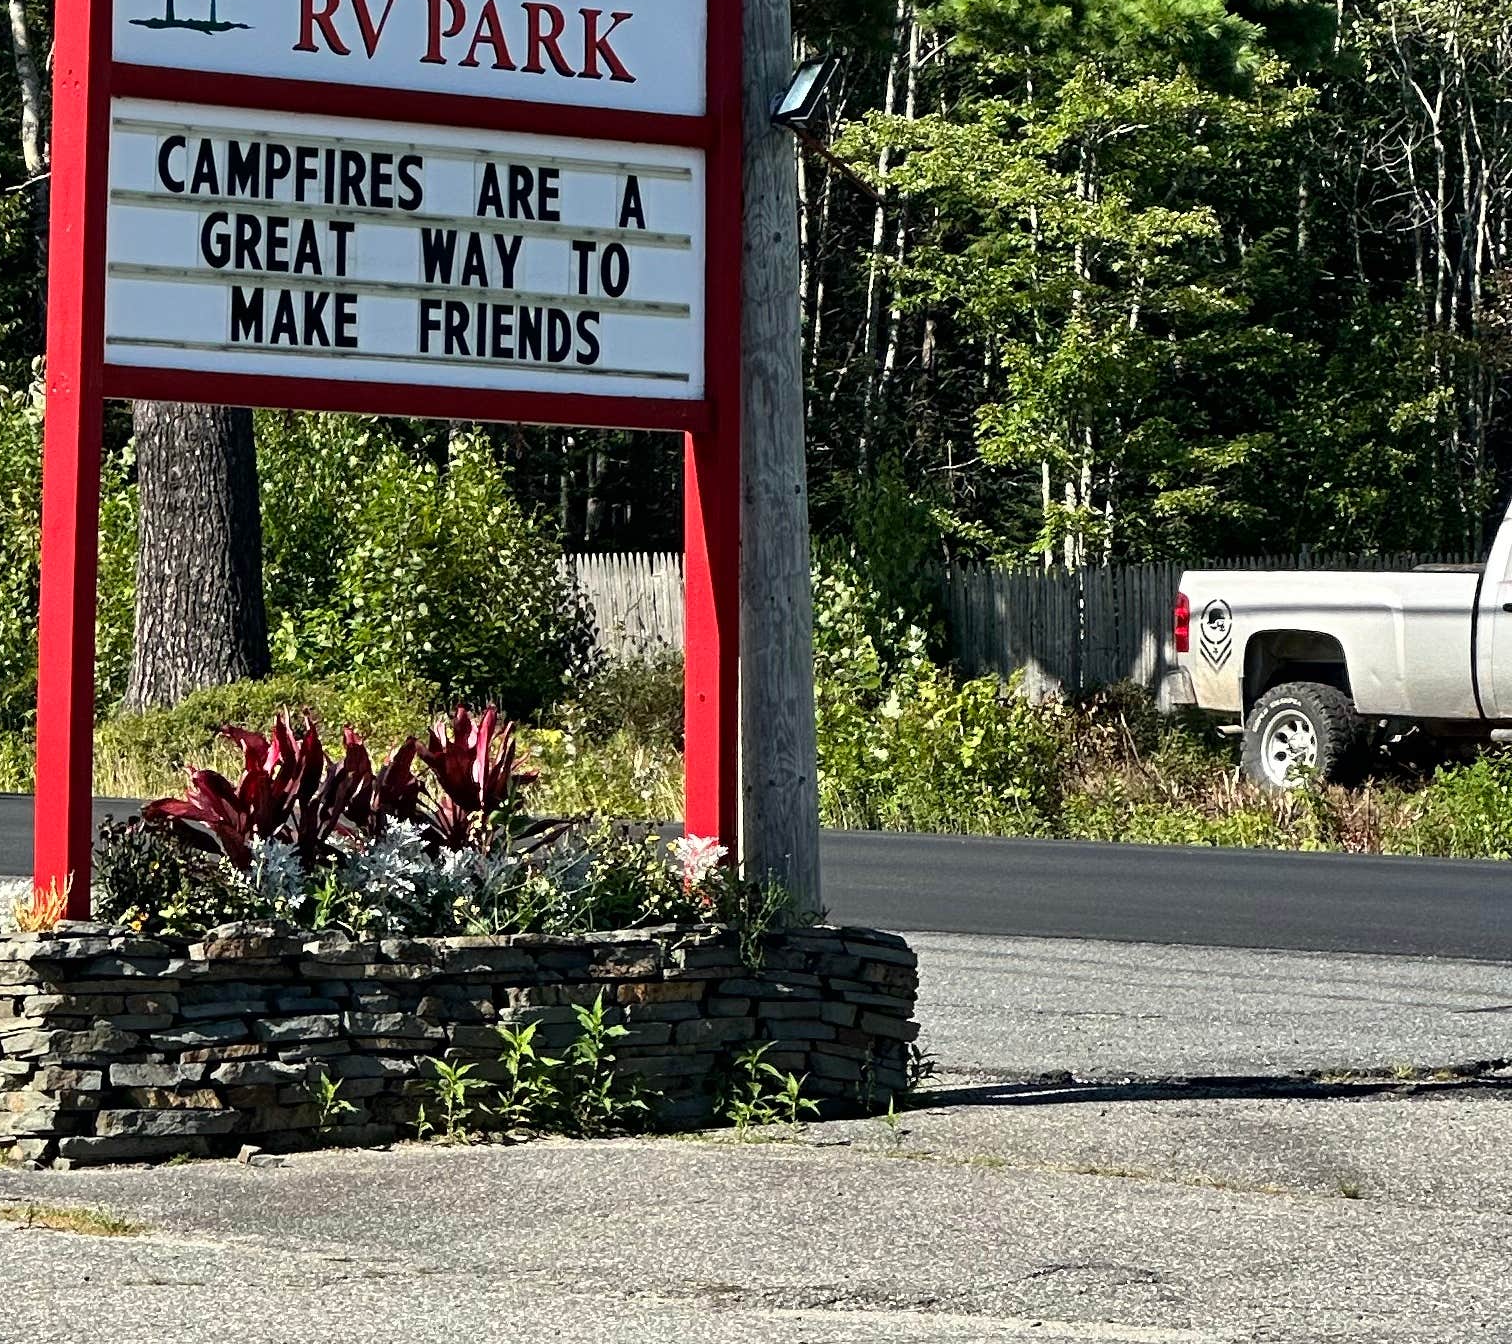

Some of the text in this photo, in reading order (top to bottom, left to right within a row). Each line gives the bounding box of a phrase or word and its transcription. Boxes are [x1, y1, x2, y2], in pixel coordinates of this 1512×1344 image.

[157, 135, 645, 230] CAMPFIRES ARE A
[201, 211, 629, 298] GREAT WAY TO
[230, 286, 600, 365] MAKE FRIENDS
